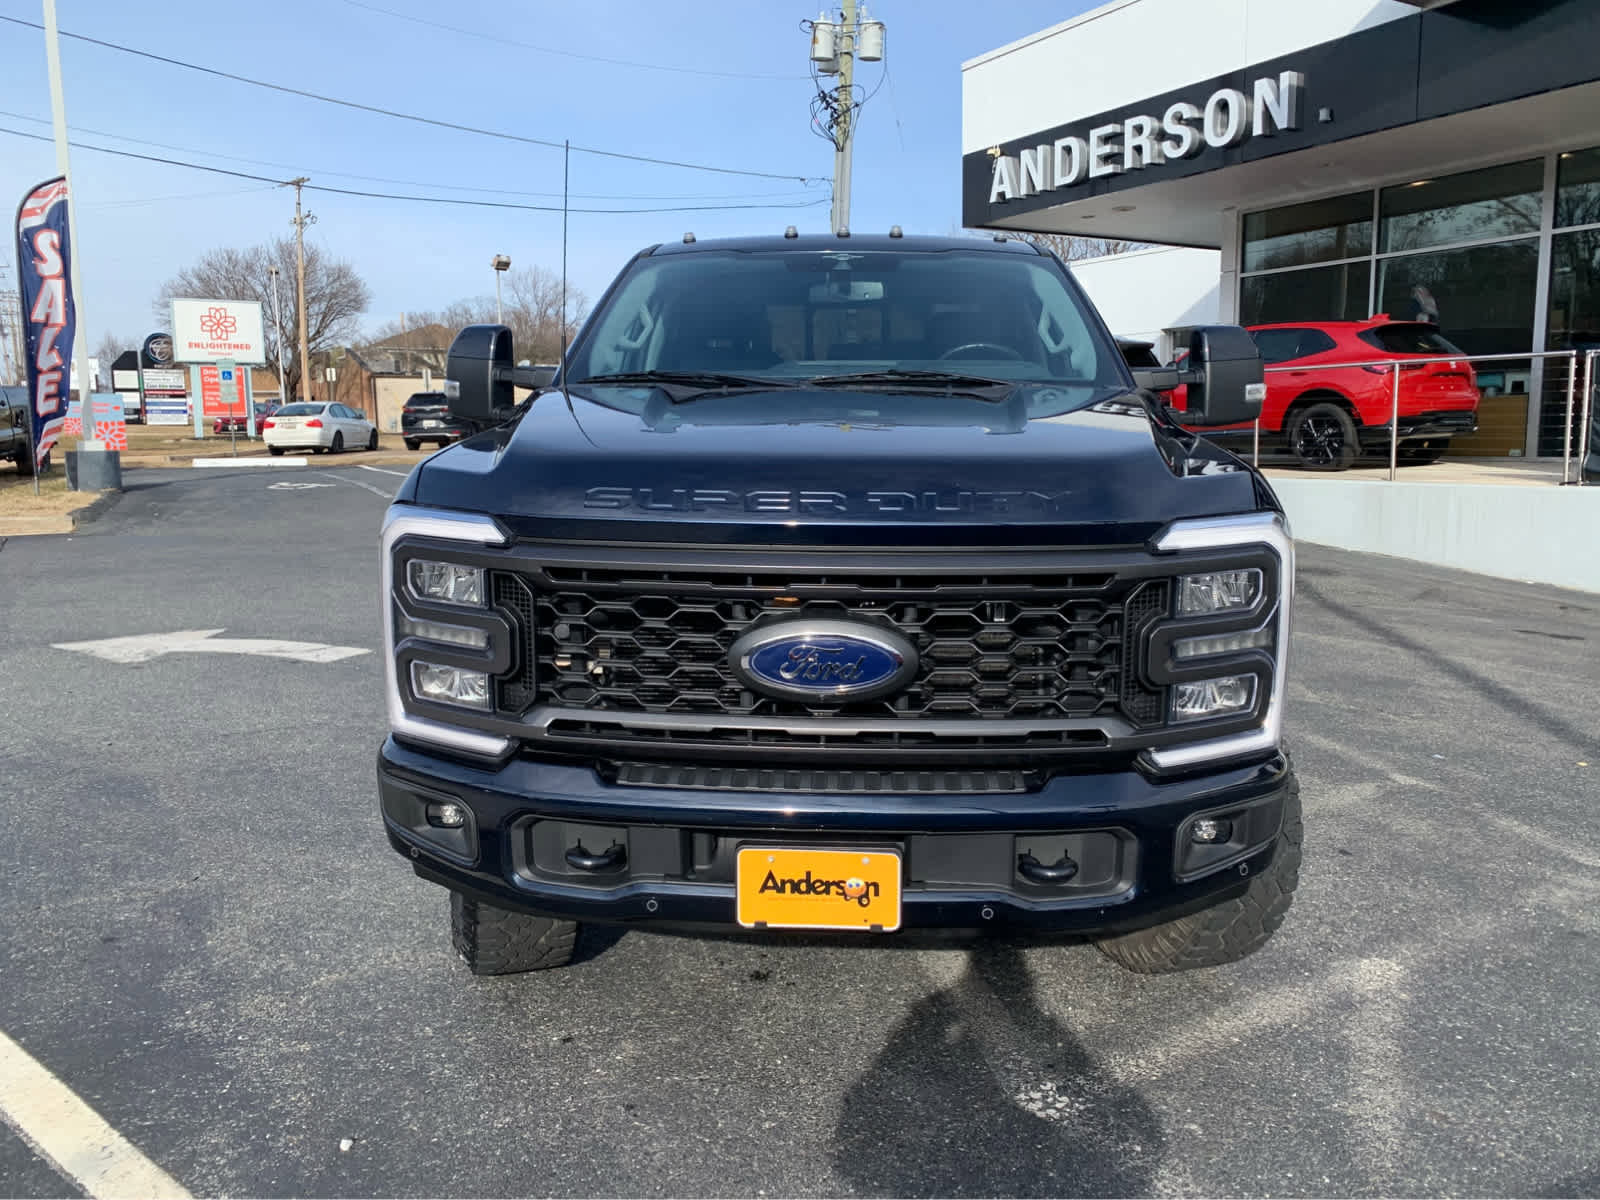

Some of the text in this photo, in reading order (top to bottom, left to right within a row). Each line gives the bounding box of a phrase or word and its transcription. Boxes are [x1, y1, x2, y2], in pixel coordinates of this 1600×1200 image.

[989, 70, 1304, 204] ANDERSON
[31, 228, 67, 418] SALE
[188, 341, 252, 351] ENLIGHTENED
[583, 486, 1073, 513] SUPER DUTY
[779, 645, 867, 681] Ford
